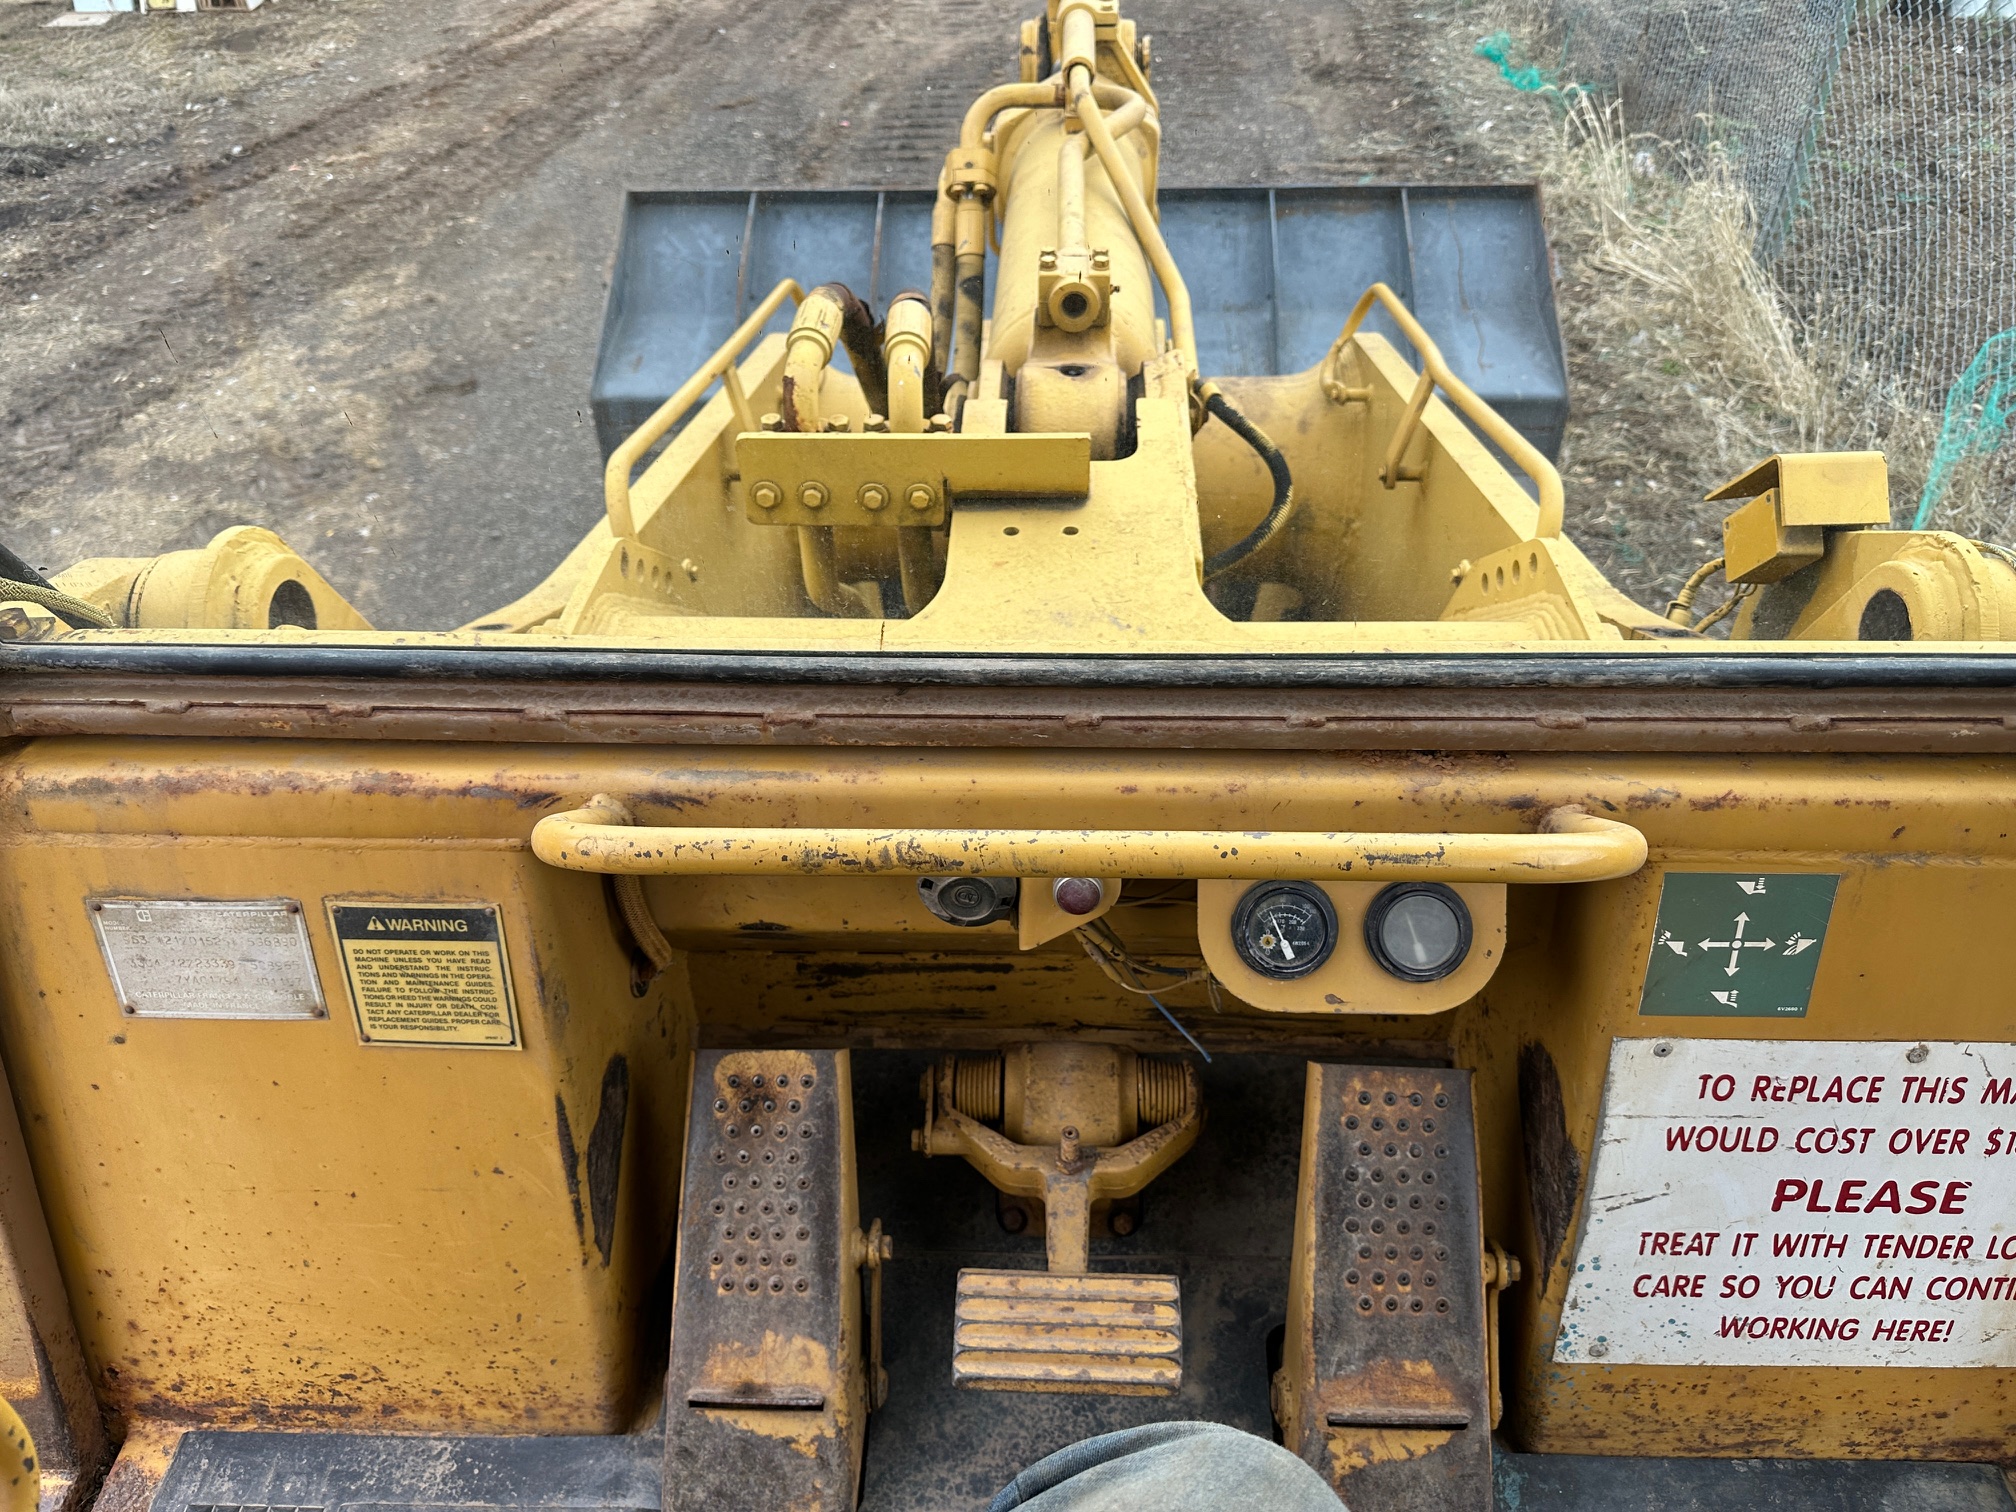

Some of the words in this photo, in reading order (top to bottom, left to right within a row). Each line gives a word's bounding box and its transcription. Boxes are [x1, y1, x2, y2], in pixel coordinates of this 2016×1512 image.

[385, 919, 468, 932] WARNING
[1698, 1074, 1736, 1101] TO
[1751, 1075, 1885, 1103] REPLACE
[1902, 1076, 1968, 1104] THIS
[1666, 1126, 1779, 1152] WOULD
[1795, 1127, 1876, 1154] COST
[1888, 1128, 1970, 1154] OVER
[1984, 1126, 2016, 1157] $1
[1771, 1179, 1972, 1214] PLEASE
[1638, 1232, 1720, 1256] TREAT
[1732, 1233, 1759, 1257] IT
[1772, 1233, 1848, 1258] WITH
[1864, 1234, 1974, 1259] TENDER
[1633, 1274, 1706, 1298] CARE
[1720, 1275, 1760, 1298] SO
[1776, 1275, 1836, 1299] YOU
[1850, 1276, 1913, 1300] CAN
[1926, 1276, 2016, 1300] CONTI
[1720, 1316, 1860, 1341] WORKING
[1872, 1319, 1954, 1342] HERE!
